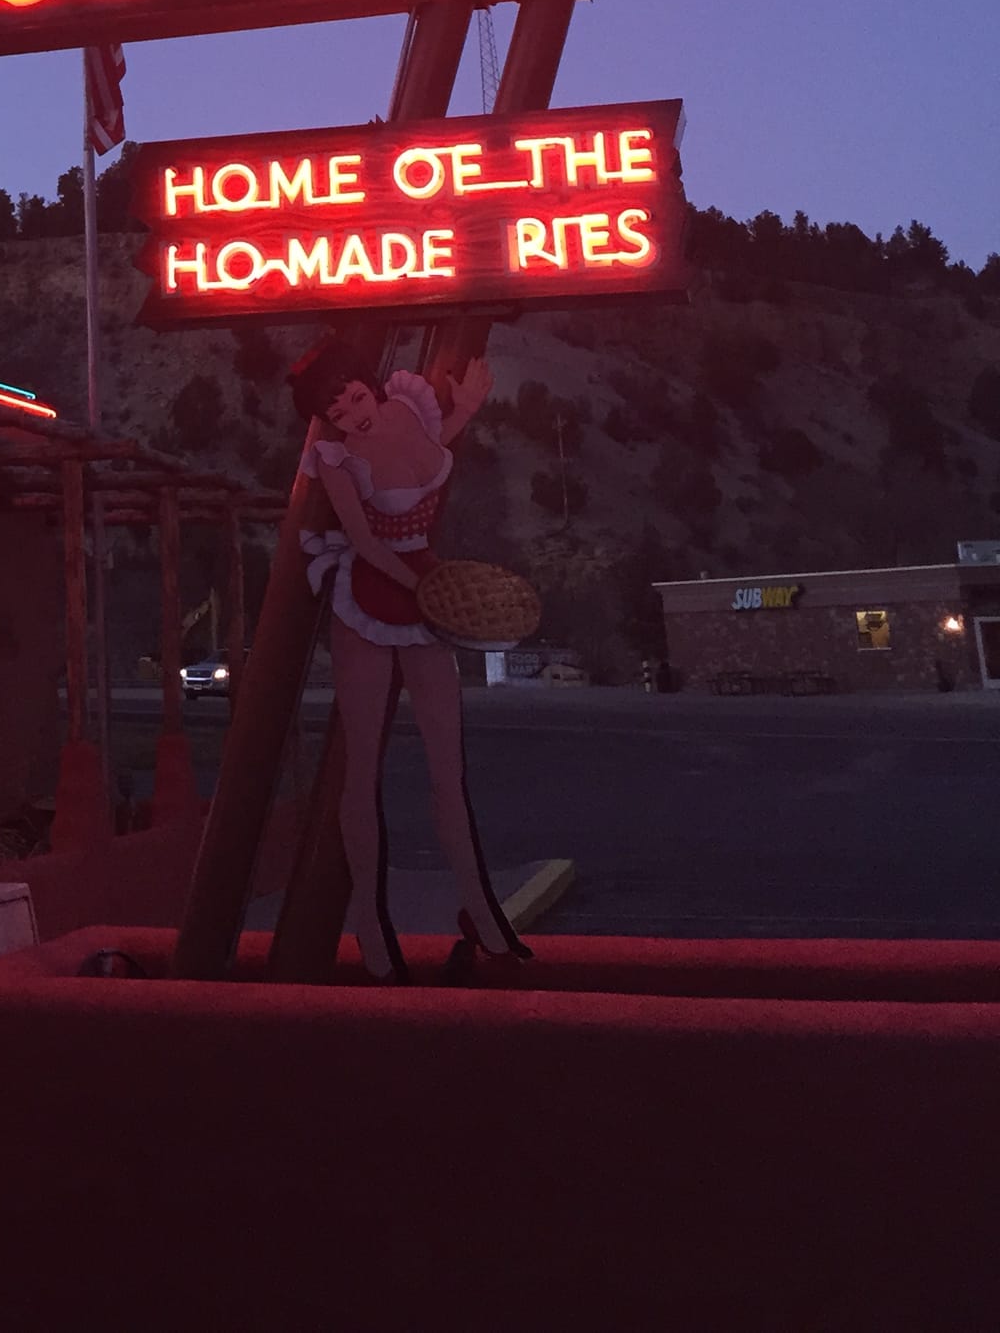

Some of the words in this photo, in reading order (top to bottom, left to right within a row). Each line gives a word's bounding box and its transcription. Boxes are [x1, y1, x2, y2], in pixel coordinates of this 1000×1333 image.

[164, 154, 366, 215] HOME
[514, 129, 658, 189] THE
[731, 585, 799, 610] SUBWAY
